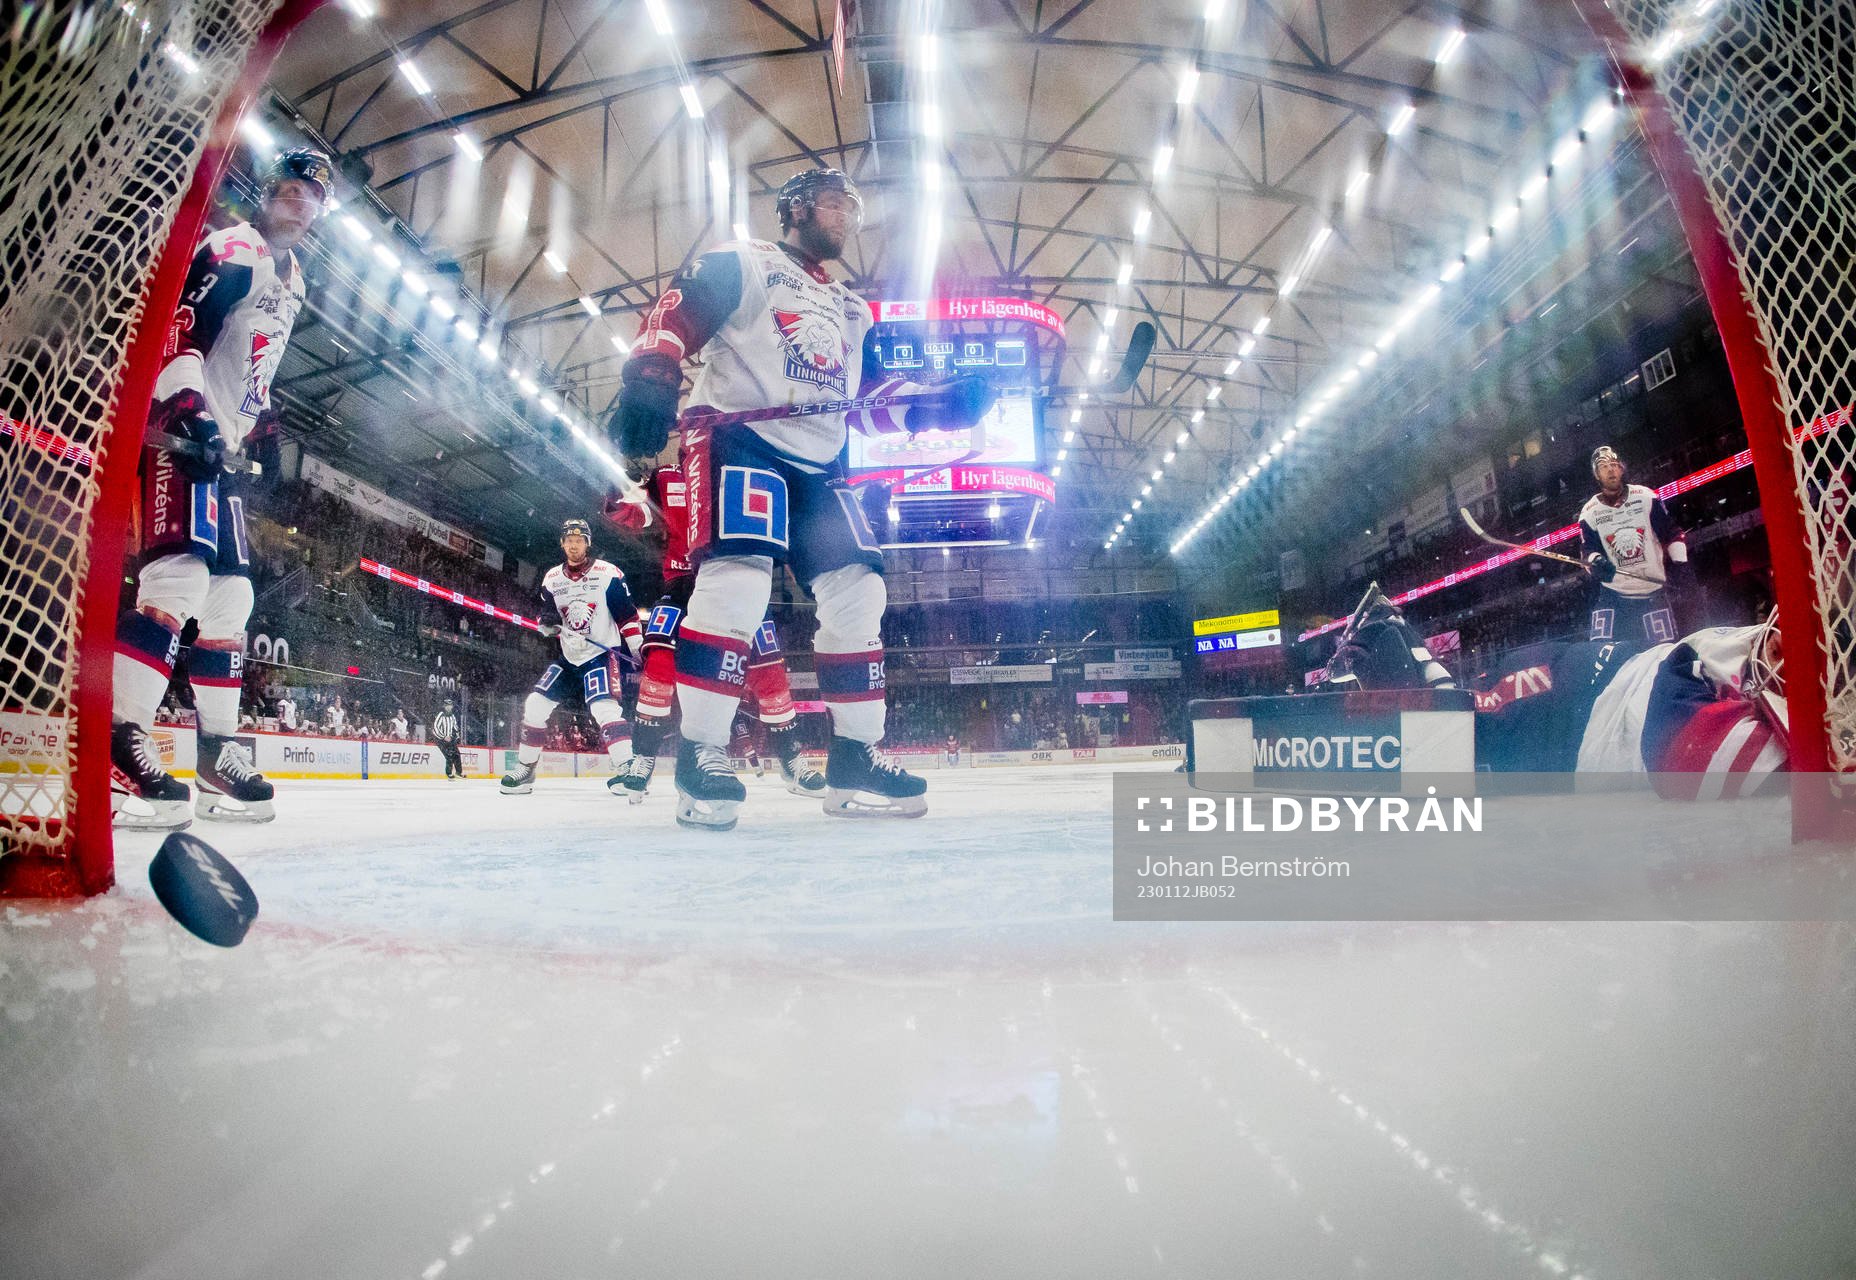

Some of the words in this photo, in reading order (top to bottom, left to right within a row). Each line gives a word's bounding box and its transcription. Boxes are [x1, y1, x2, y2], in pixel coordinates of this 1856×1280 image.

[767, 272, 804, 287] HOCKEY
[776, 279, 802, 292] STORE
[950, 302, 978, 319] Hyr
[982, 301, 1045, 321] lägenhet
[789, 398, 887, 416] JETSPEED
[961, 471, 989, 489] Hyr
[993, 470, 1045, 492] lägenhet
[1198, 618, 1243, 629] Mekonomen
[1197, 640, 1214, 652] NA
[1218, 637, 1236, 649] NA
[283, 746, 316, 764] Prinfo
[379, 751, 430, 765] BAUER
[216, 772, 236, 786] CCM
